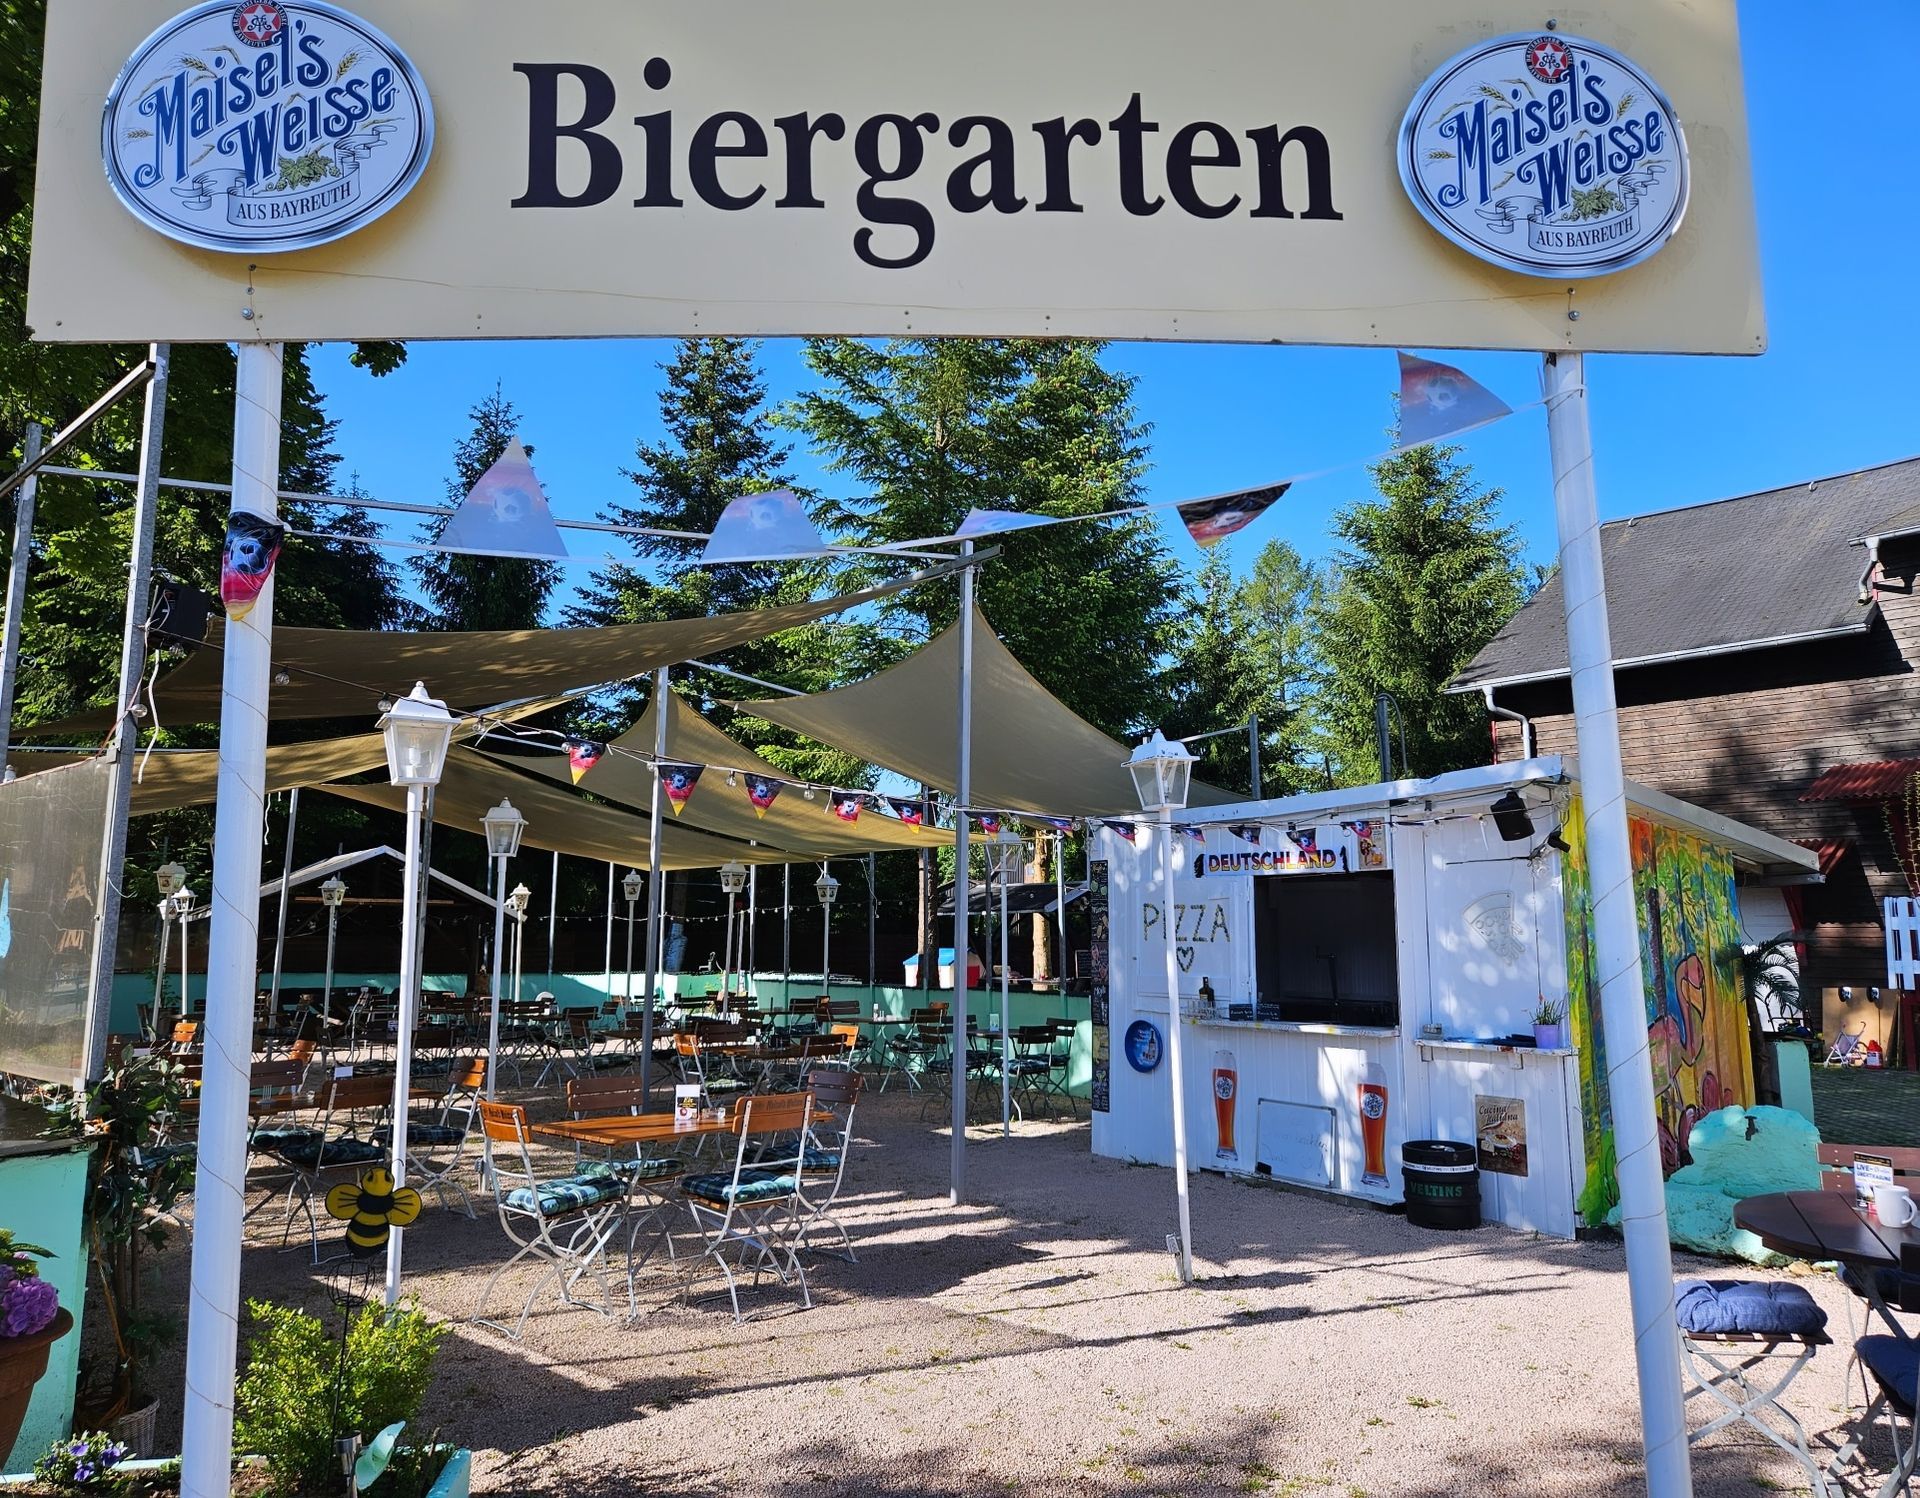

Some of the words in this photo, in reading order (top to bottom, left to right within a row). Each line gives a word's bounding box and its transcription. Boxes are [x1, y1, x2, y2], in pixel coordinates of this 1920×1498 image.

[134, 19, 330, 189] Maisel's
[217, 67, 400, 190] Weisse
[1437, 59, 1613, 208] Maisel's
[511, 56, 1344, 269] Biergarten
[1516, 110, 1667, 218] Weisse
[236, 203, 267, 220] AUS
[270, 182, 352, 220] BAYREUTH
[1536, 230, 1563, 247] AUS
[1566, 216, 1634, 248] BAYREUTH
[1208, 849, 1336, 872] DEUTSCHLAND
[1143, 900, 1230, 943] PIZZA
[1479, 1104, 1510, 1115] Cucina
[1410, 1181, 1463, 1197] VELTINS
